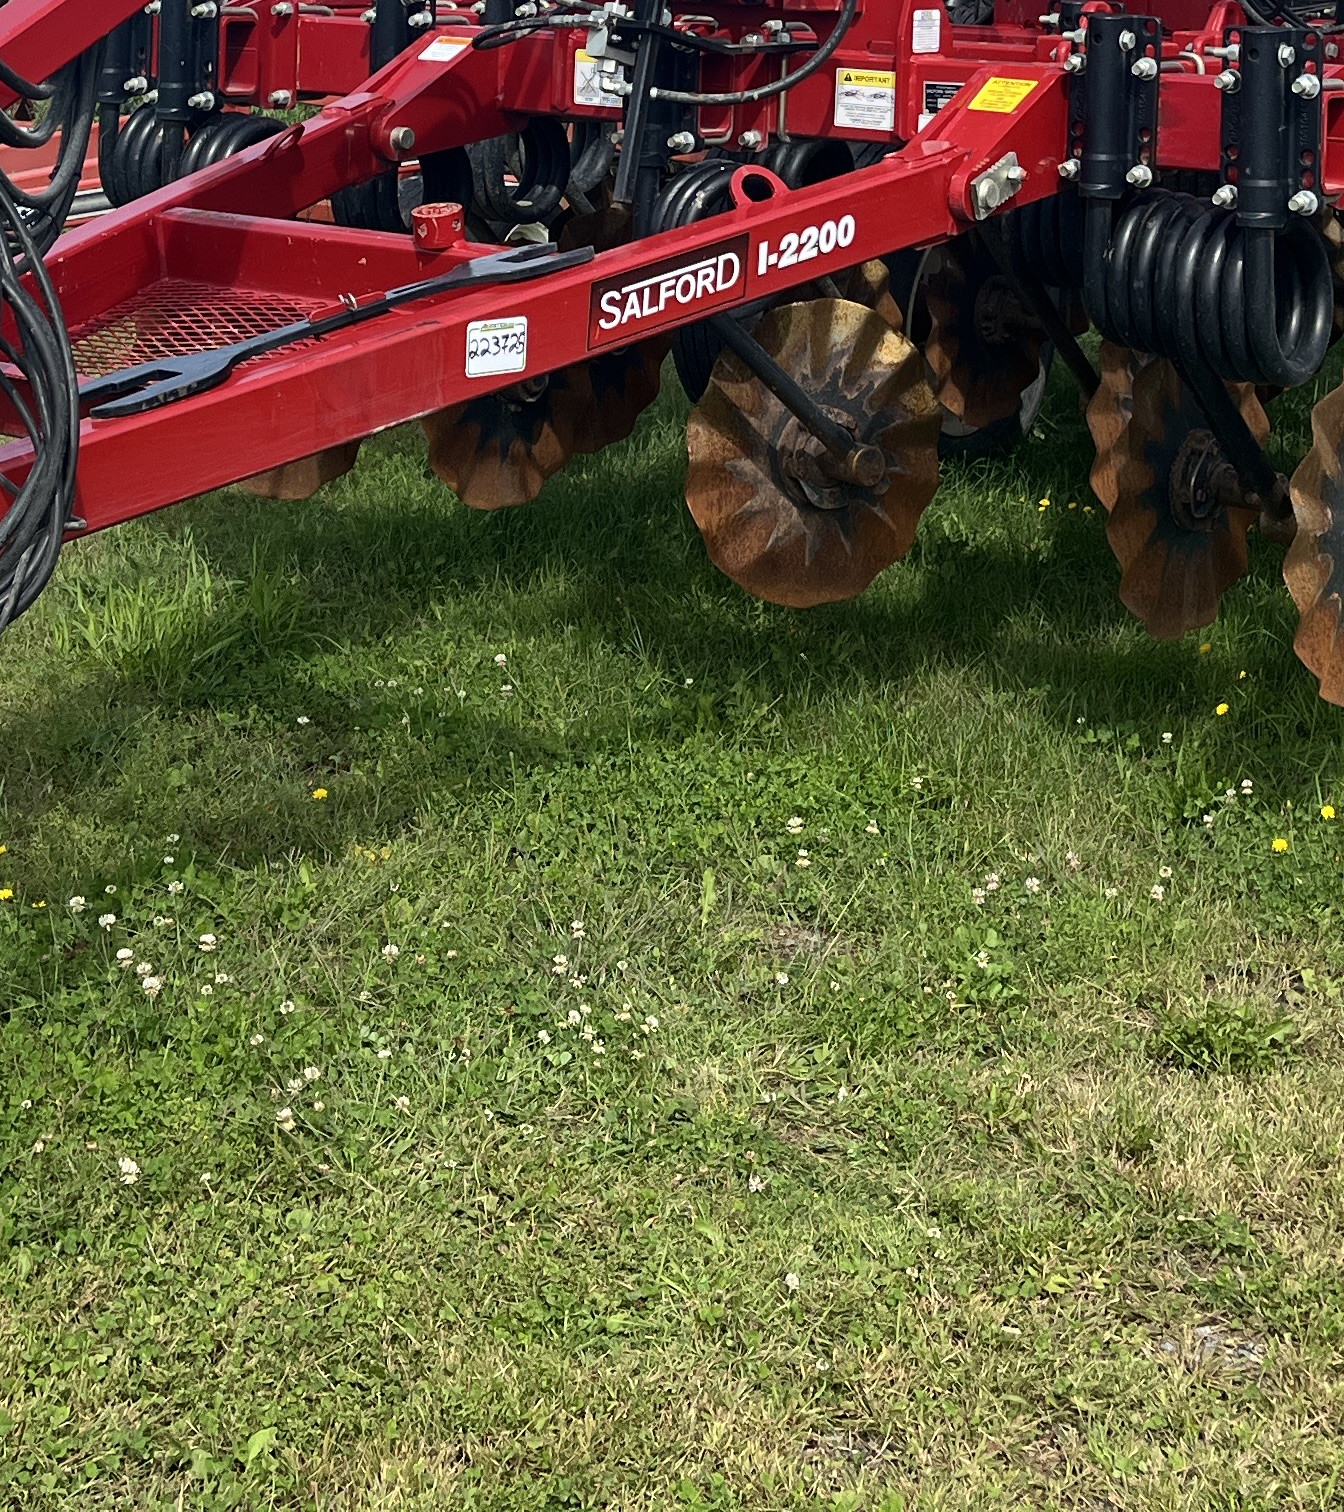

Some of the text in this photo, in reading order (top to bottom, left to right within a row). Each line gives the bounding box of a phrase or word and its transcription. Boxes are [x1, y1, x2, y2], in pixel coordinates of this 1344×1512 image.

[757, 214, 856, 276] I-2200
[598, 252, 741, 331] SALFORD
[468, 330, 526, 360] 223725
